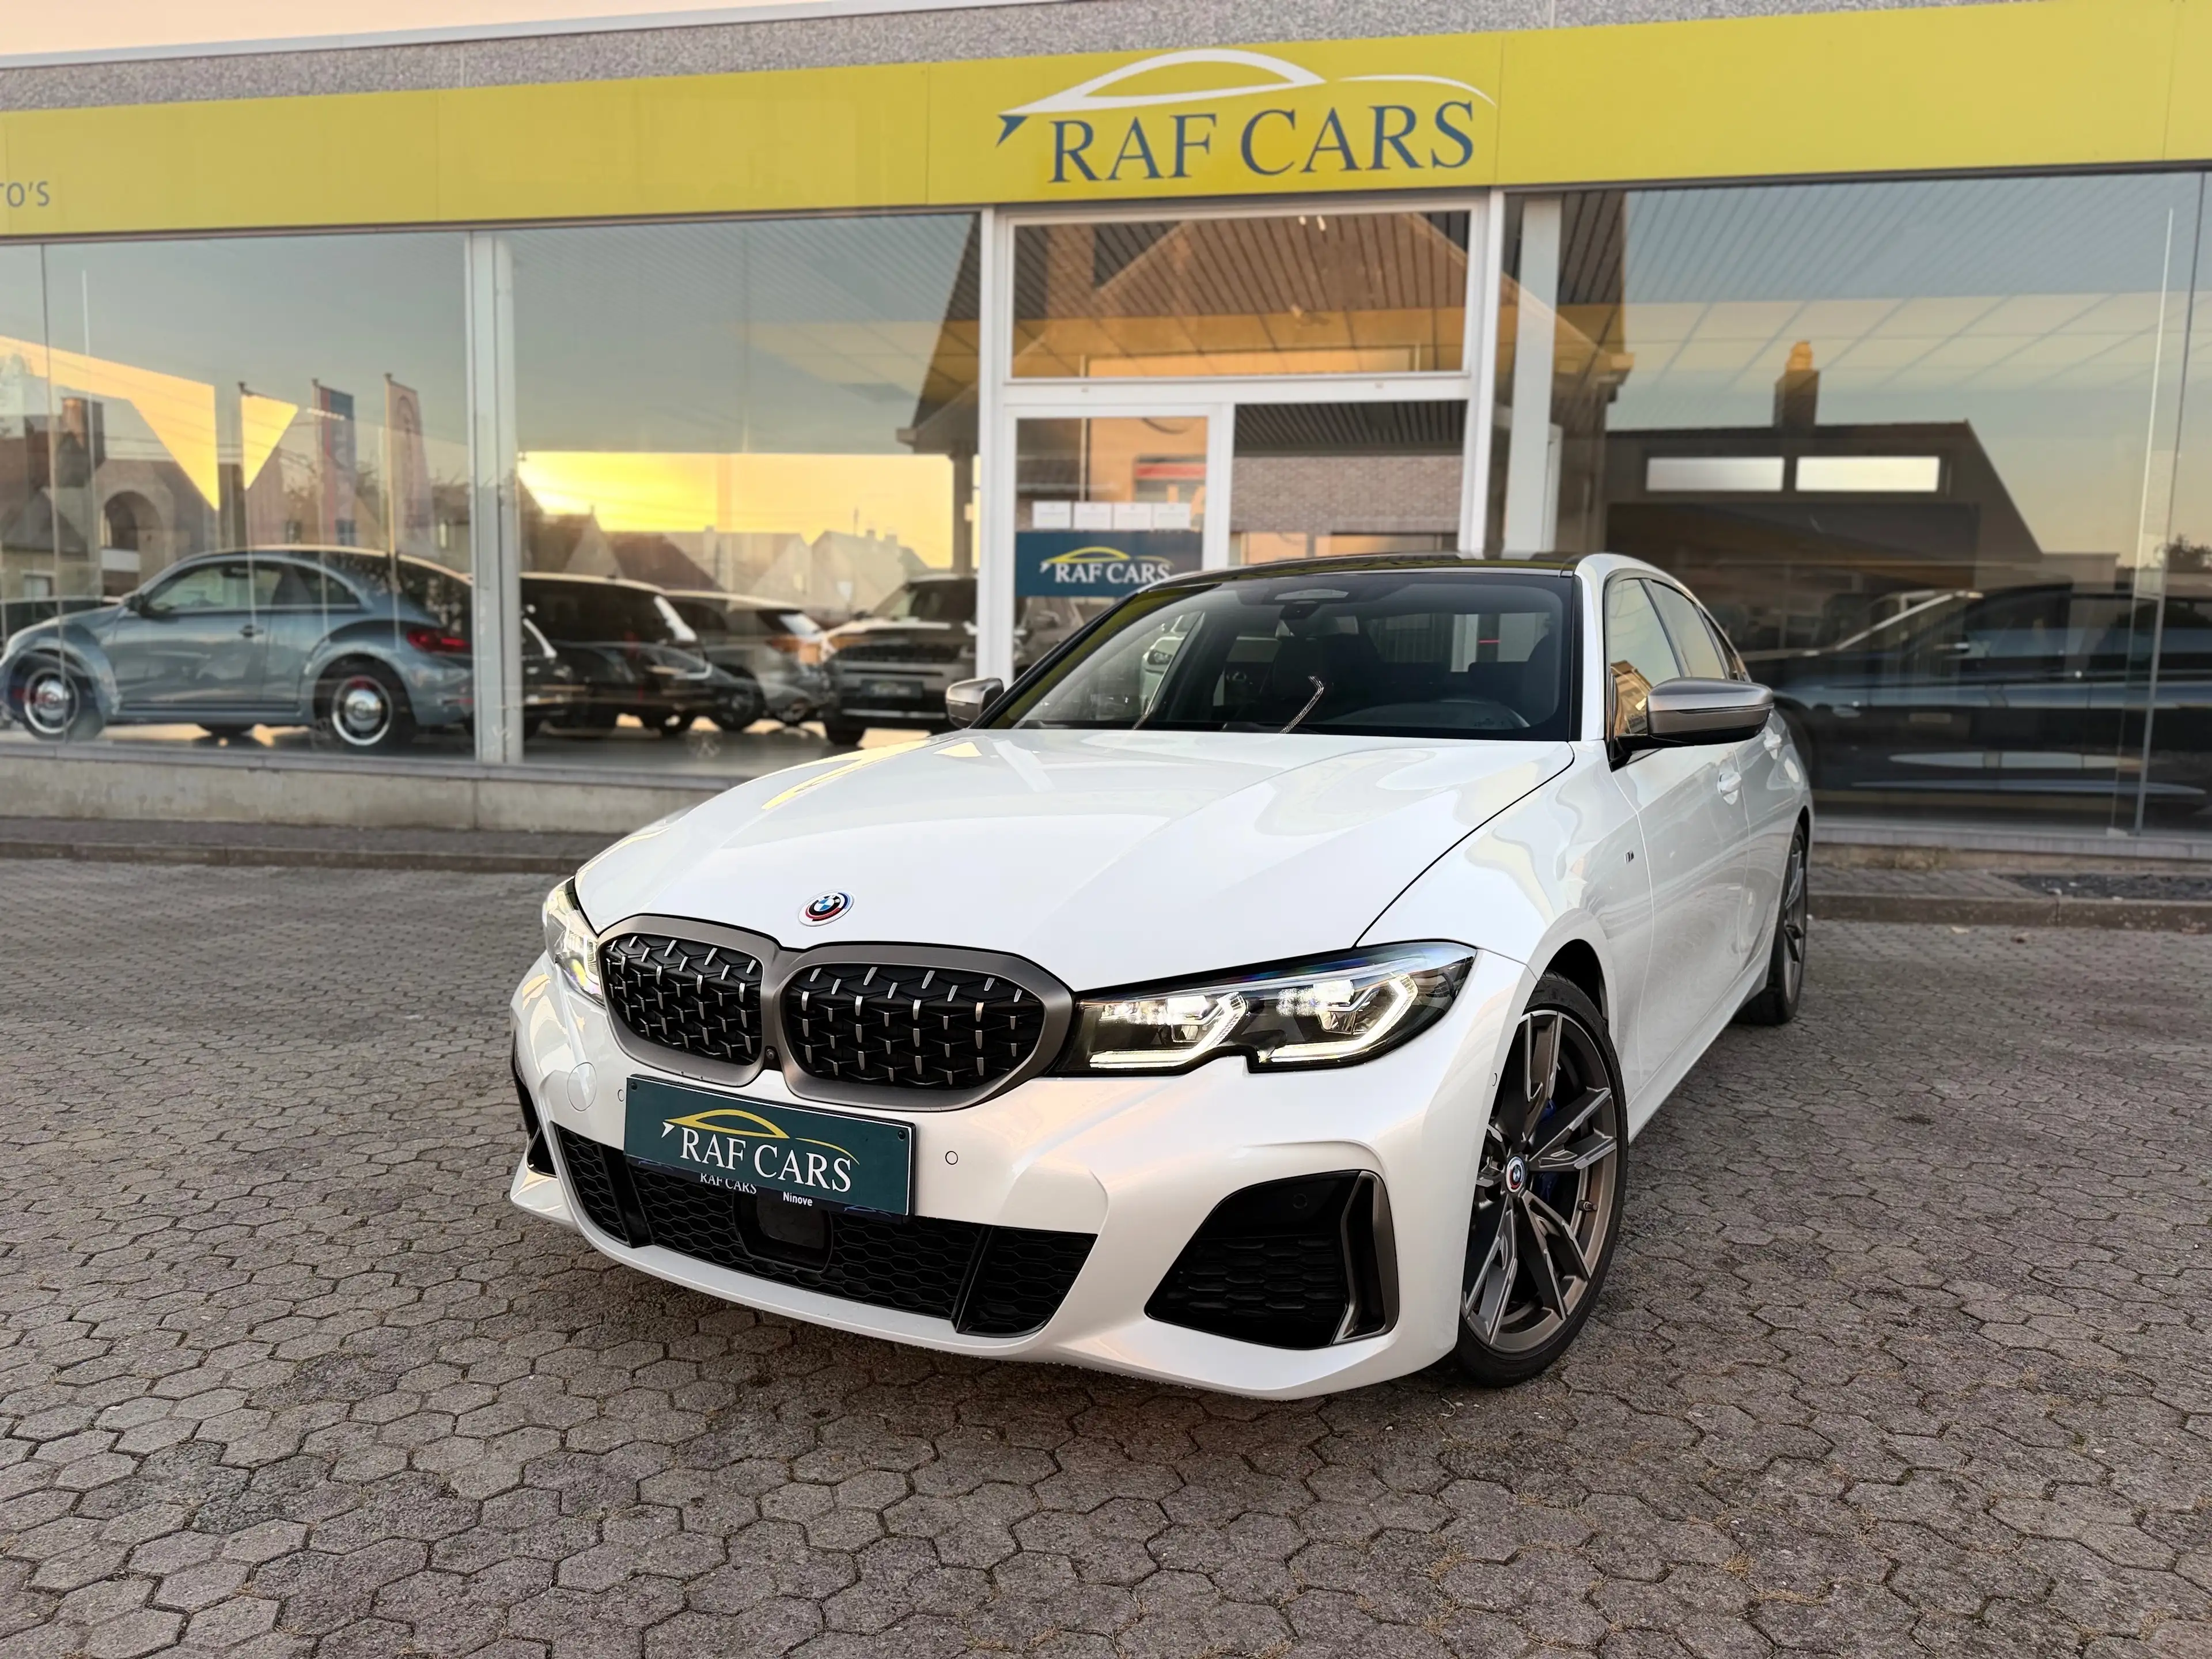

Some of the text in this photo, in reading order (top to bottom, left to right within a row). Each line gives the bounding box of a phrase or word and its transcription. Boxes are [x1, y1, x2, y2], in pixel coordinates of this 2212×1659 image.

[1048, 100, 1475, 183] RAF CARS
[1055, 562, 1170, 584] RAF CARS
[680, 1127, 851, 1192] RAF CARS
[782, 1191, 813, 1207] Ninove
